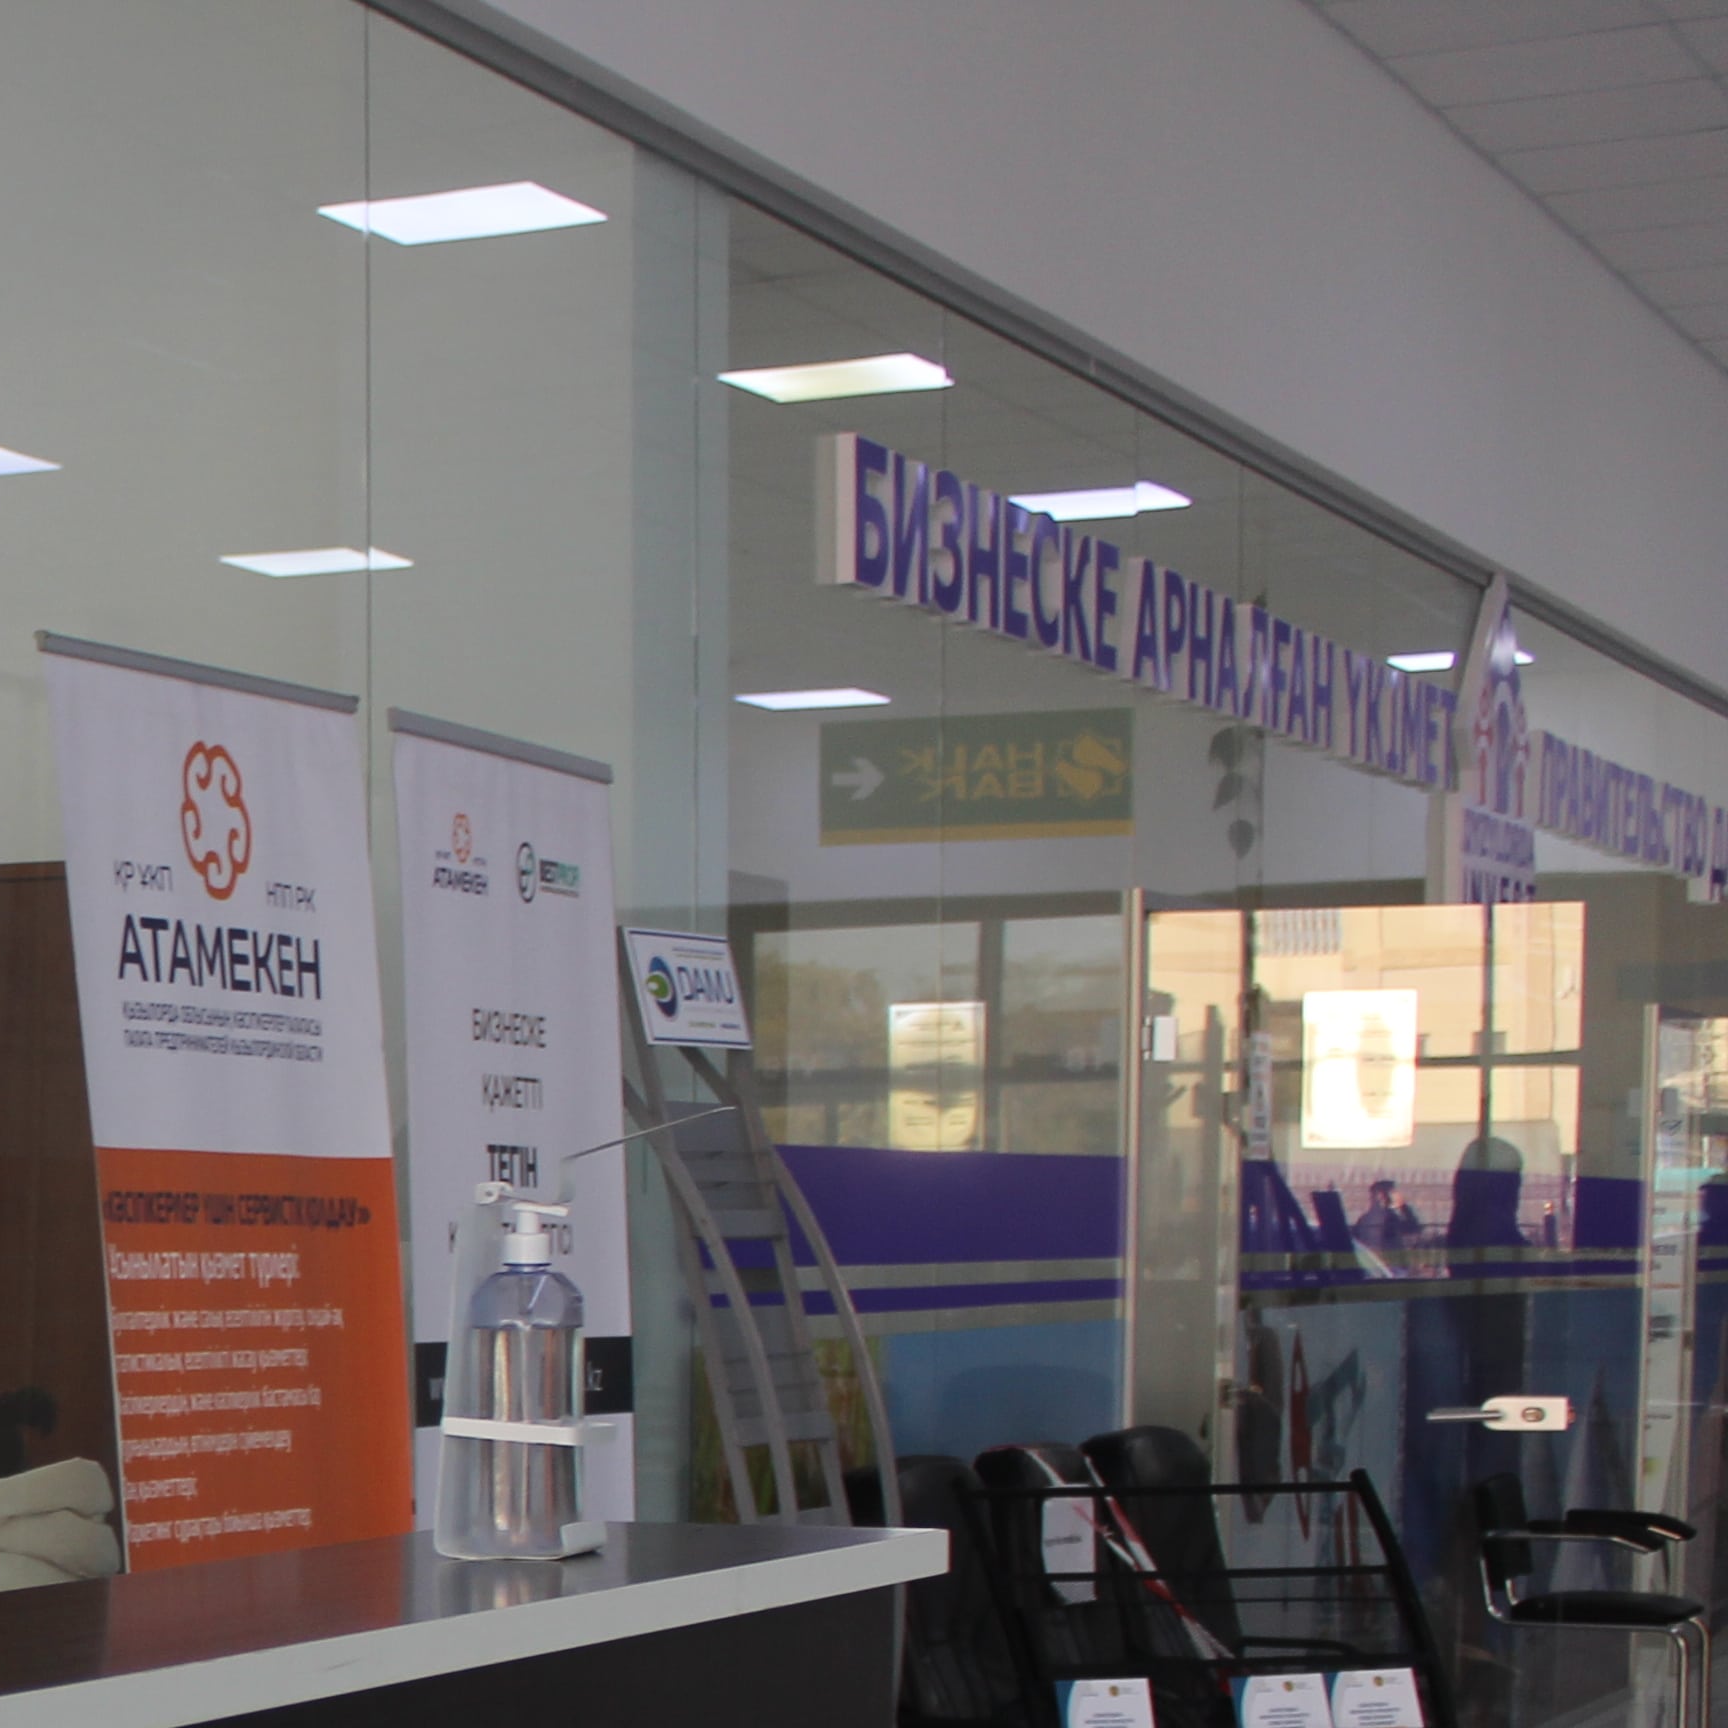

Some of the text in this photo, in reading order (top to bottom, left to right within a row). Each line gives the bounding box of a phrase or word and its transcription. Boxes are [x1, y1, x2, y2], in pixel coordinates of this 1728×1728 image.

[855, 435, 1120, 671] БИЗНЕСКЕ
[1132, 558, 1335, 750] АРНАЛҒАН
[117, 913, 322, 1001] АТАМЕКЕН
[472, 1007, 547, 1048] БИЗНЕСКЕ
[481, 1073, 542, 1113] ҚАЖЕТТІ
[487, 1143, 539, 1189] ТЕГІН
